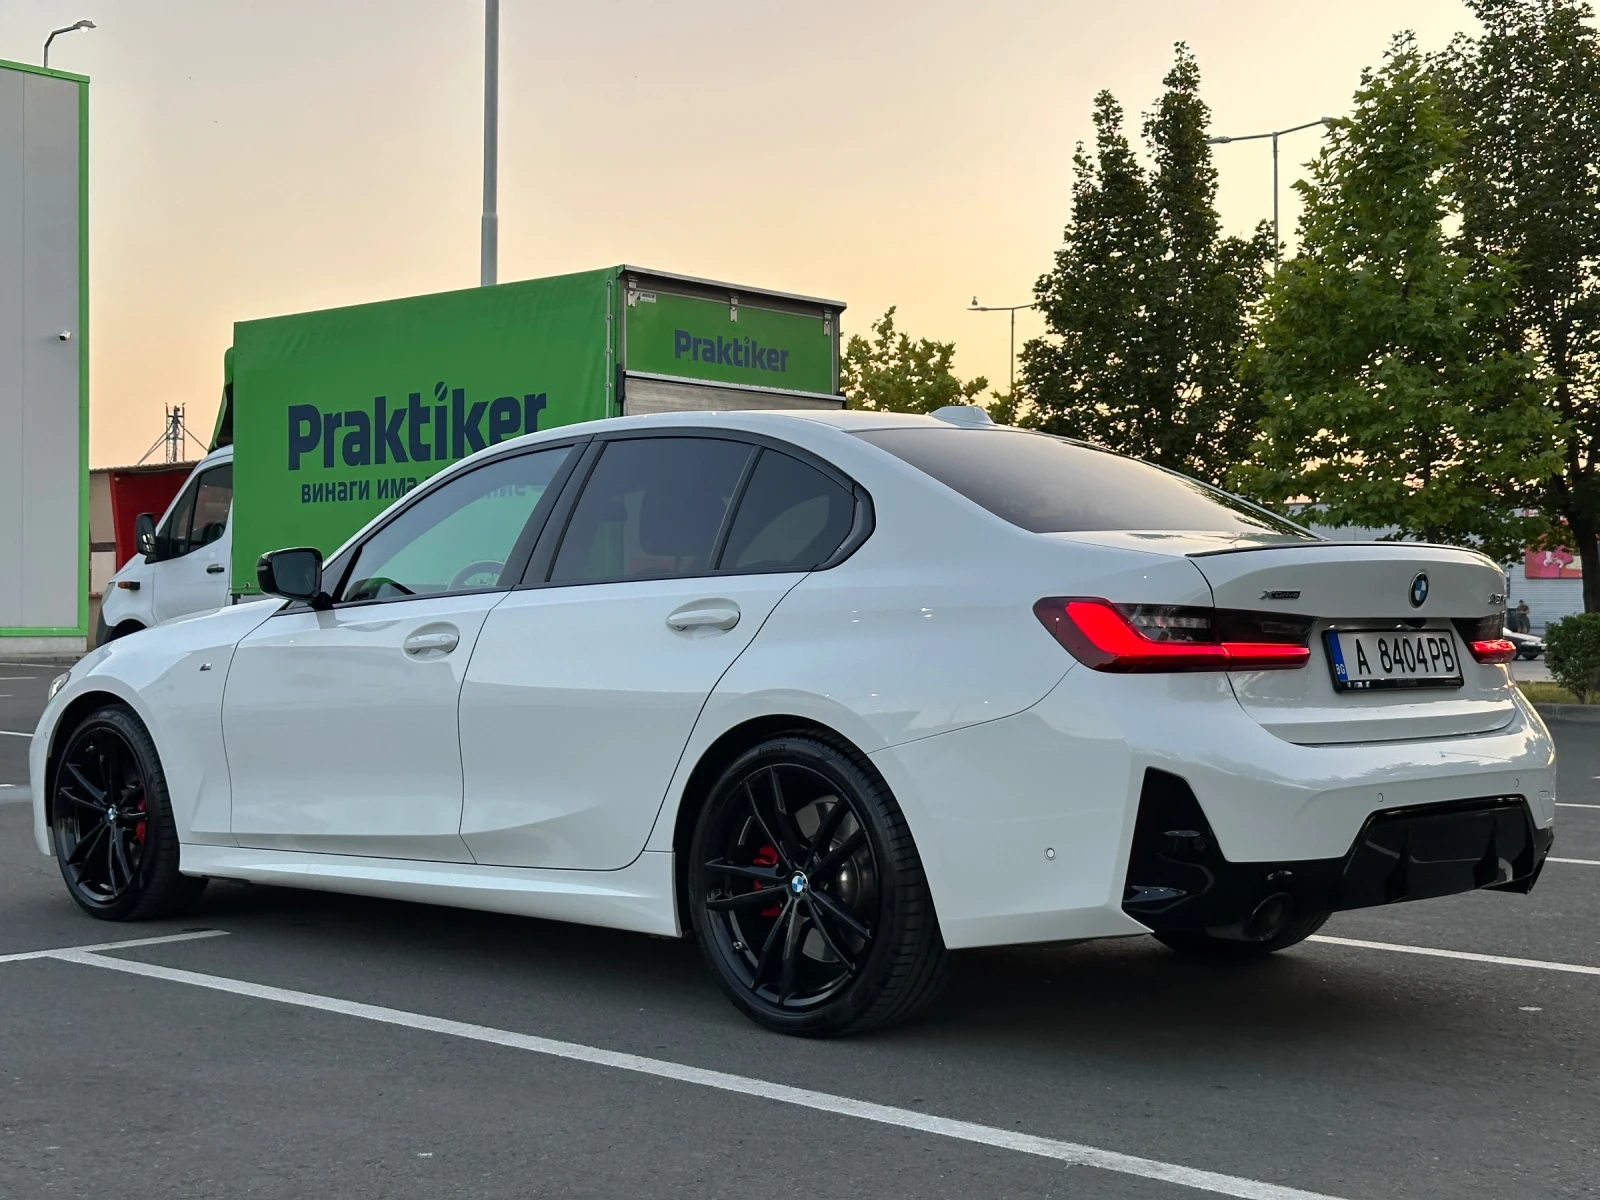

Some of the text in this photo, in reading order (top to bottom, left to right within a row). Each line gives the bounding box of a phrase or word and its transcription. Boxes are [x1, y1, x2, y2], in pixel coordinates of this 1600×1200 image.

[674, 329, 789, 372] Praktiker
[288, 381, 547, 471] Praktiker
[301, 479, 370, 503] винаги
[1335, 663, 1346, 675] BG
[1355, 638, 1372, 675] A
